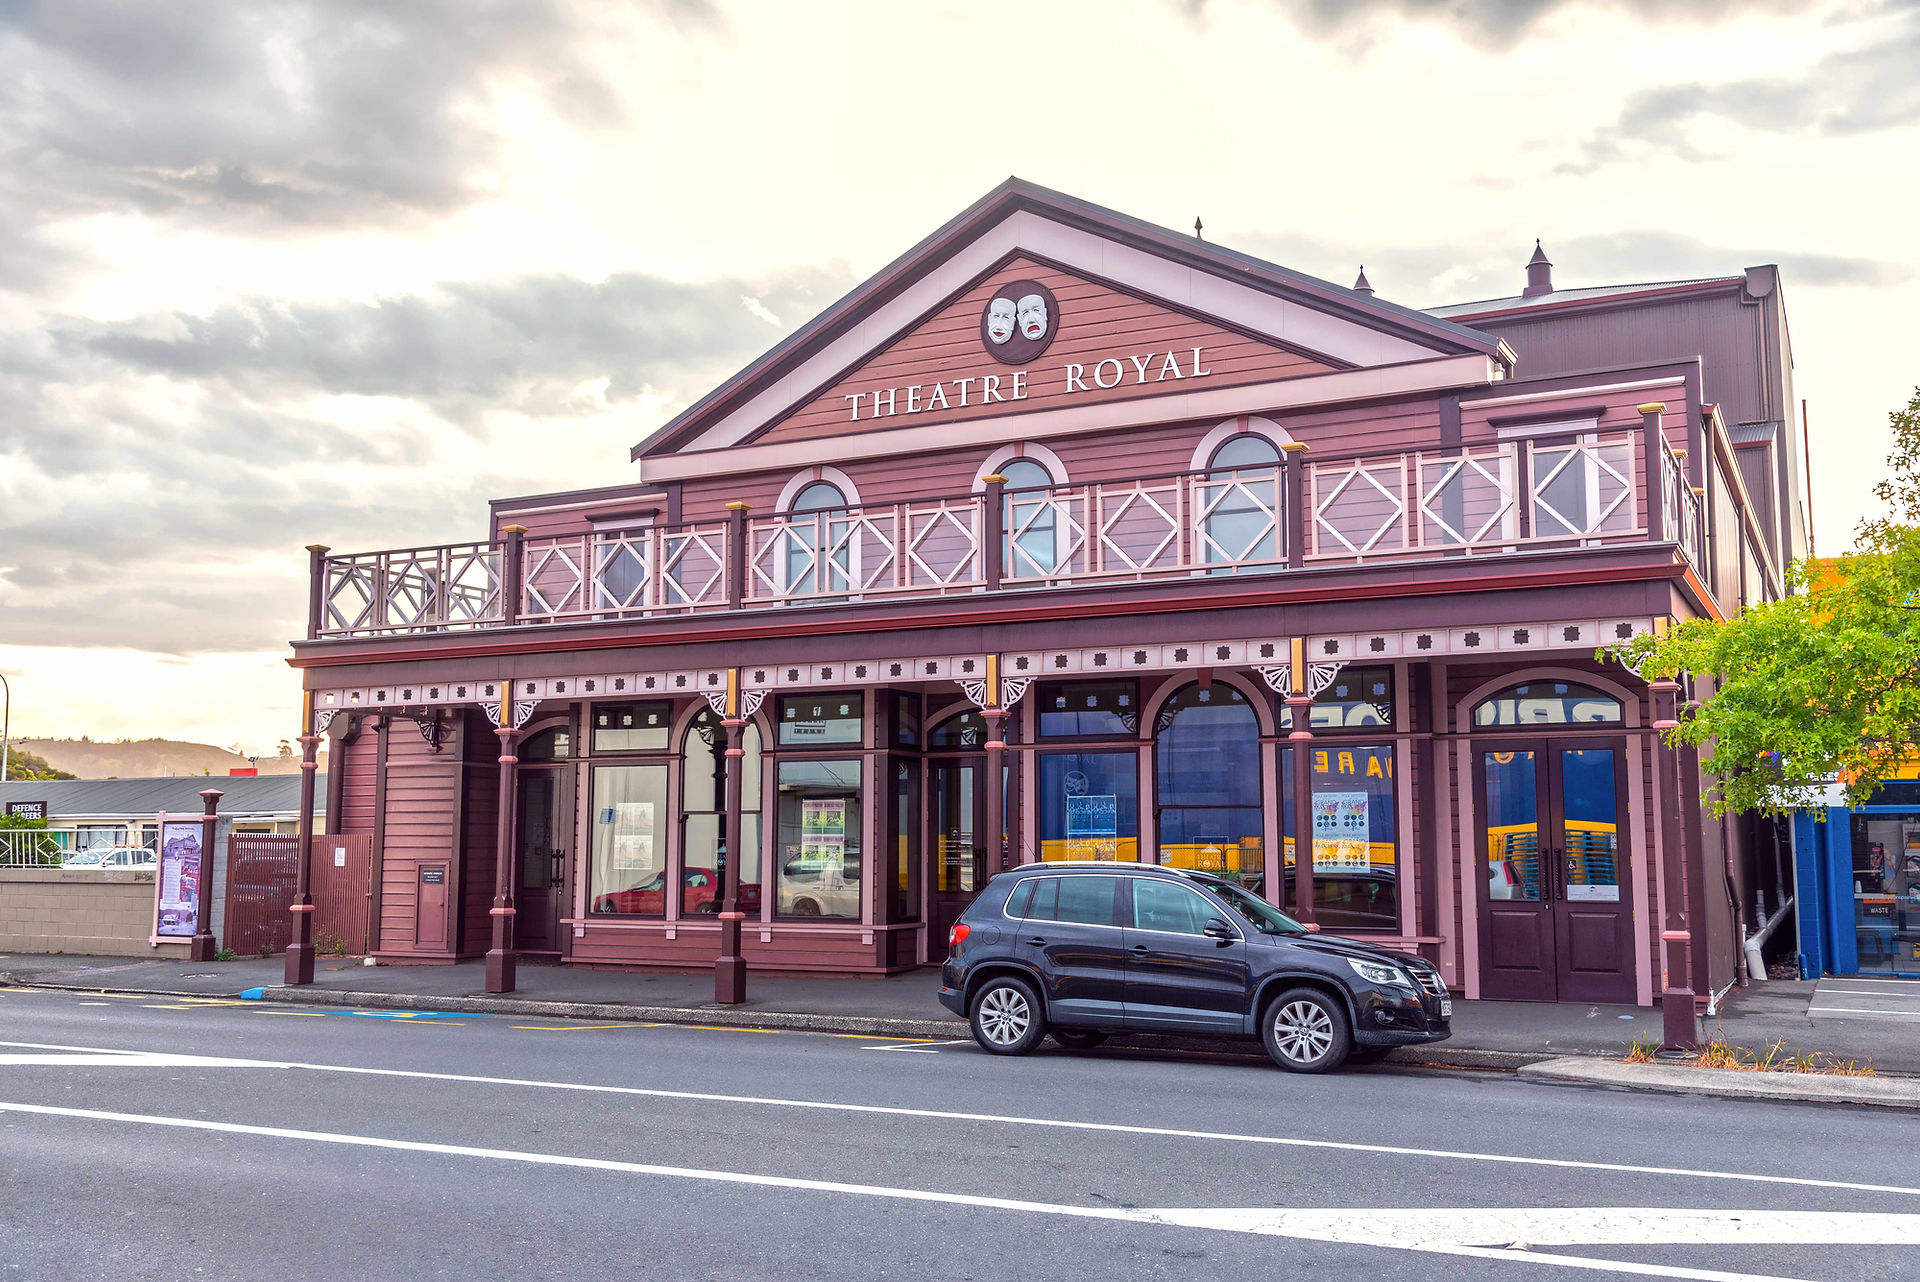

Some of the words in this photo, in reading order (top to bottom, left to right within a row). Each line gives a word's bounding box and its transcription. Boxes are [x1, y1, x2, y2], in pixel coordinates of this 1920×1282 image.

[845, 371, 1029, 422] THEATRE
[1064, 346, 1212, 394] ROYAL
[12, 803, 42, 812] DEFENCE
